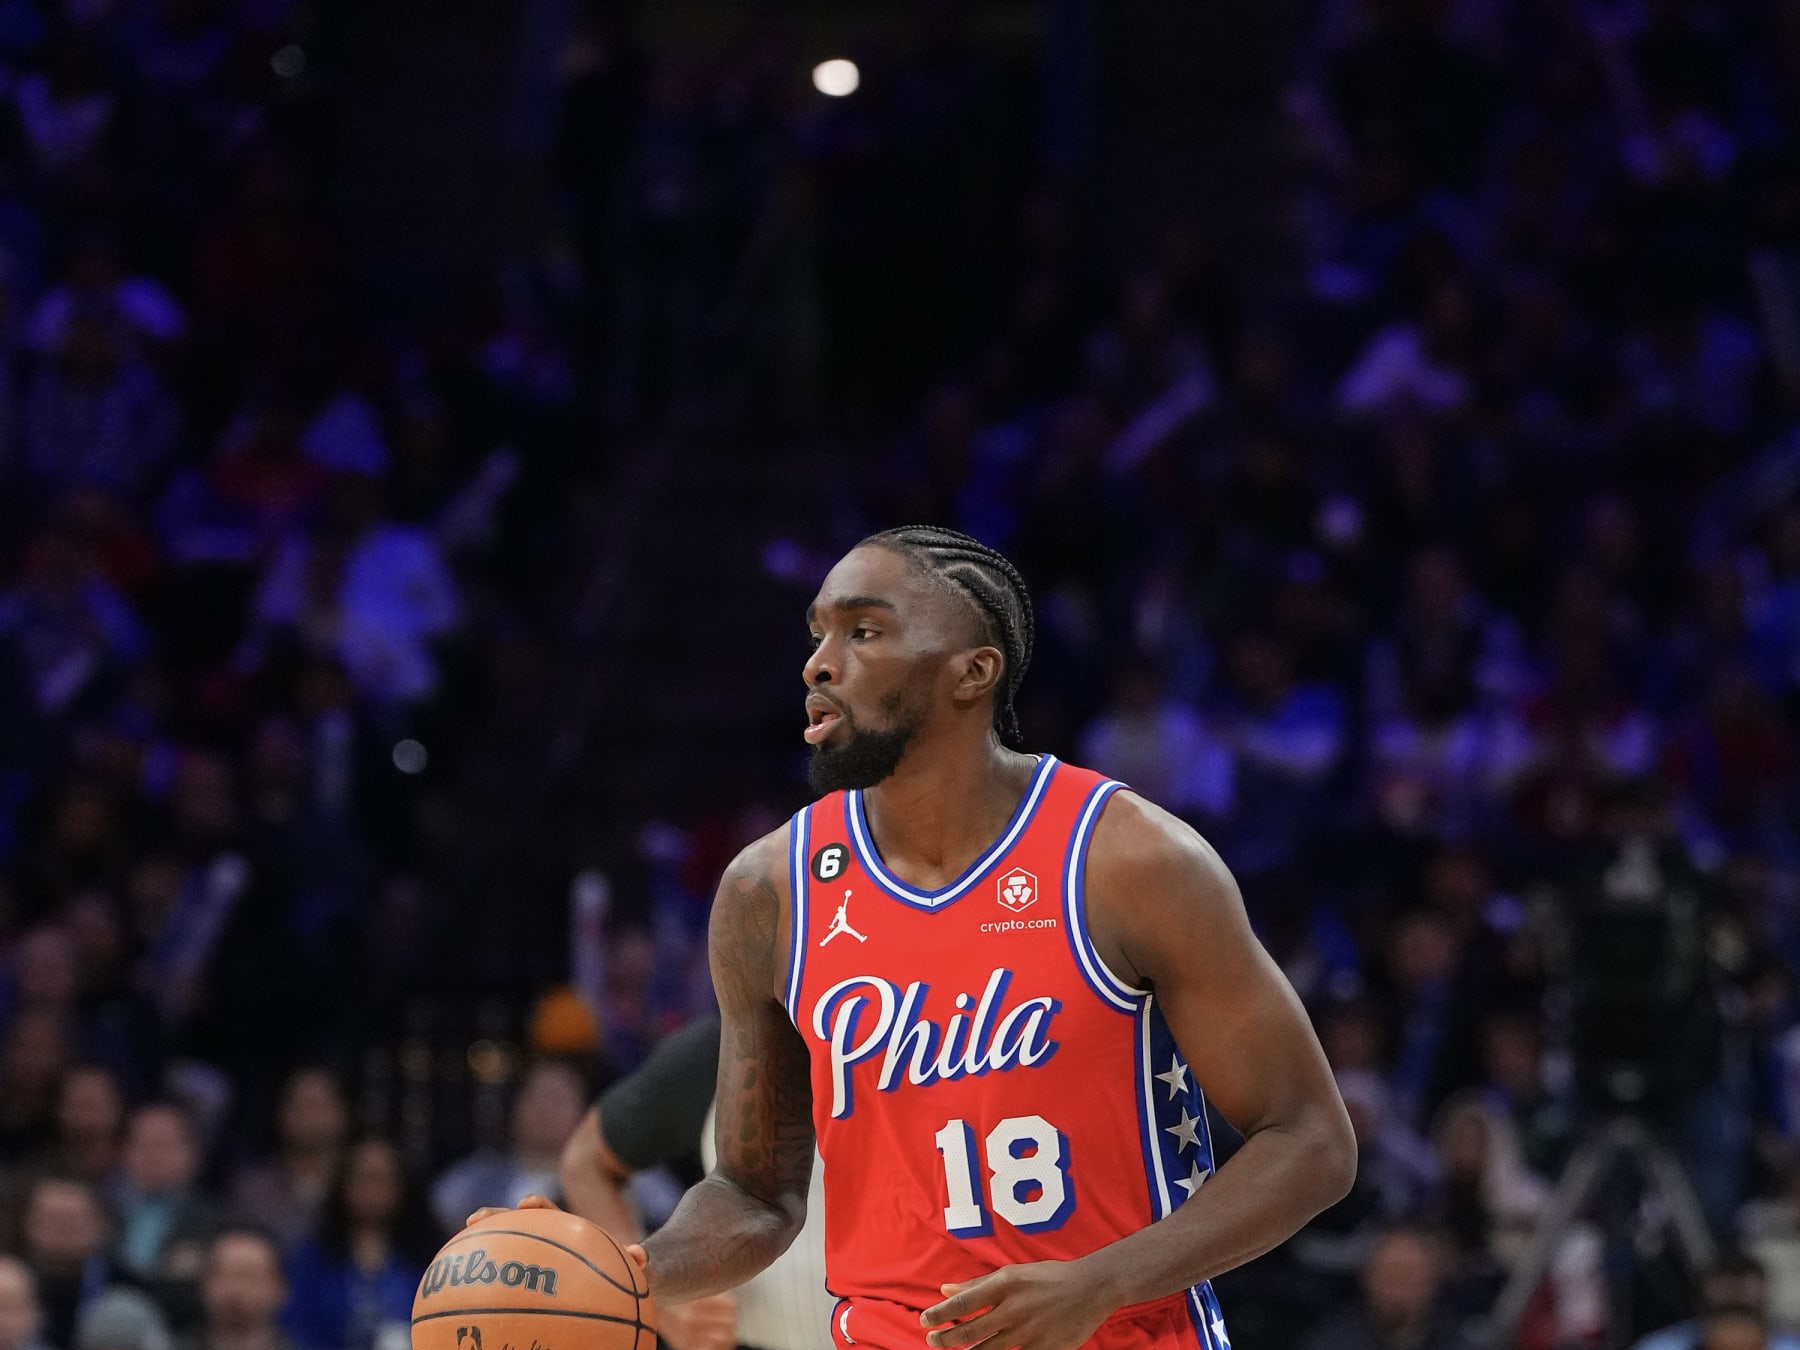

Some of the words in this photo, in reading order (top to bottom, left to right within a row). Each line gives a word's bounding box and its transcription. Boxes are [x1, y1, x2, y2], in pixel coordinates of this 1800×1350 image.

[819, 848, 842, 879] 6
[980, 918, 1057, 934] crypto.com
[812, 967, 1061, 1120] Phila
[935, 1114, 1074, 1237] 18
[421, 1248, 558, 1299] Wilson
